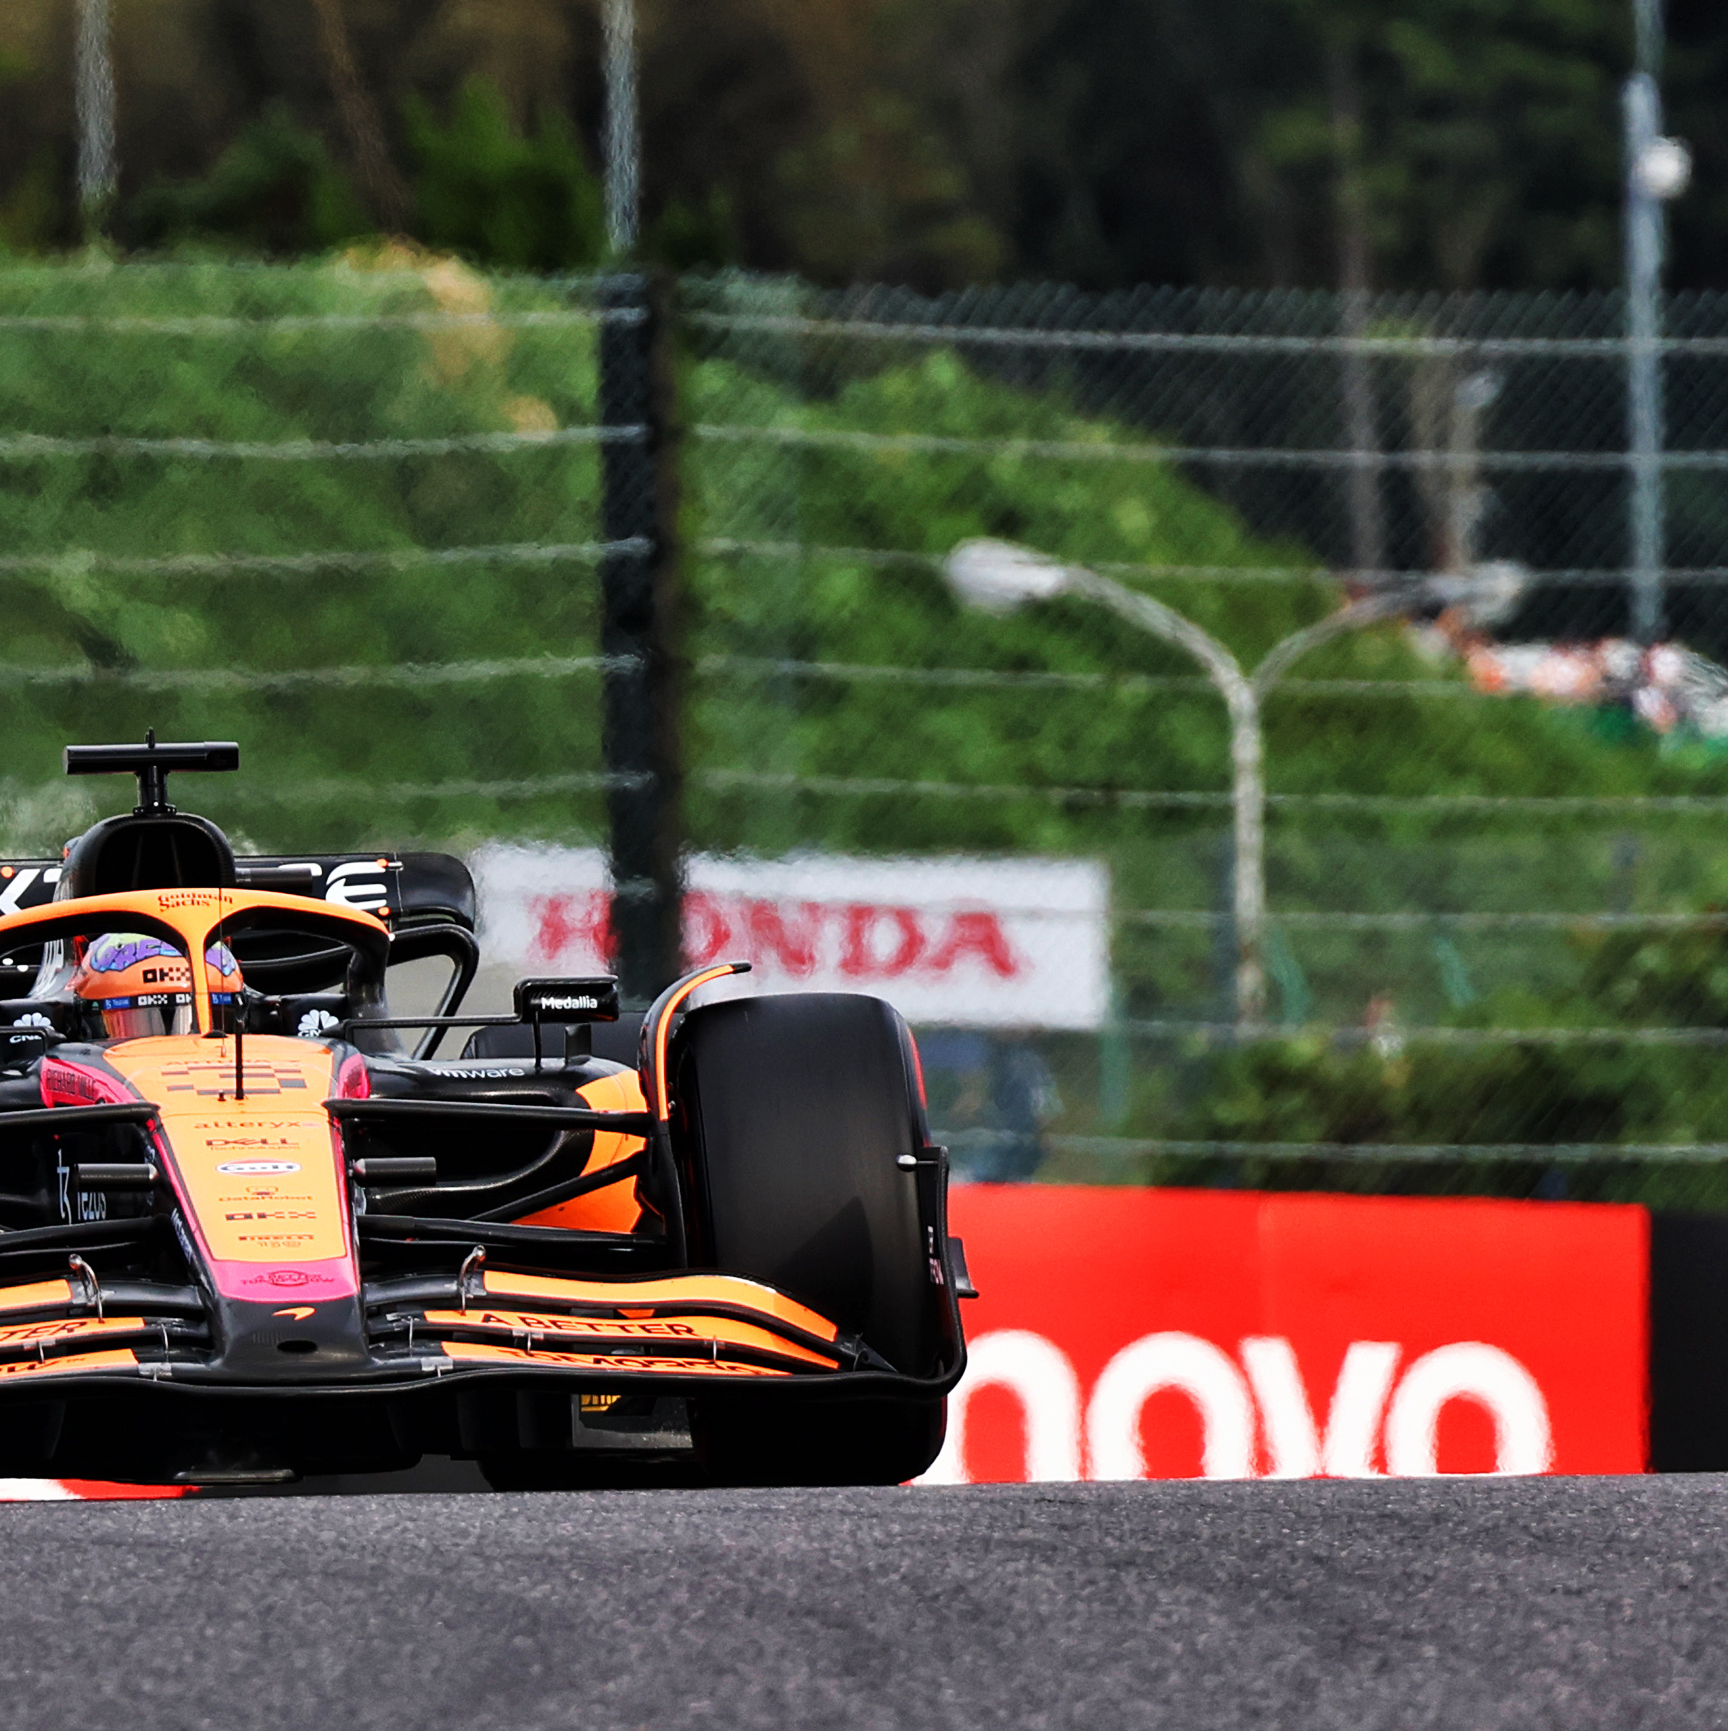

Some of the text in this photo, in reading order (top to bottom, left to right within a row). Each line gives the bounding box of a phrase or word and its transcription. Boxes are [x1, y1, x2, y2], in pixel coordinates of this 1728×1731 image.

[157, 892, 233, 905] Goldman
[159, 899, 210, 912] Sachs
[138, 994, 168, 1006] OKX
[176, 993, 192, 1004] OK
[541, 996, 598, 1010] Medallia
[429, 1066, 525, 1078] vmware
[194, 1120, 301, 1129] alteryx
[206, 1138, 300, 1146] DELL
[225, 1212, 317, 1221] OKX
[480, 1313, 697, 1337] A BETTER
[918, 1329, 1553, 1479] novo
